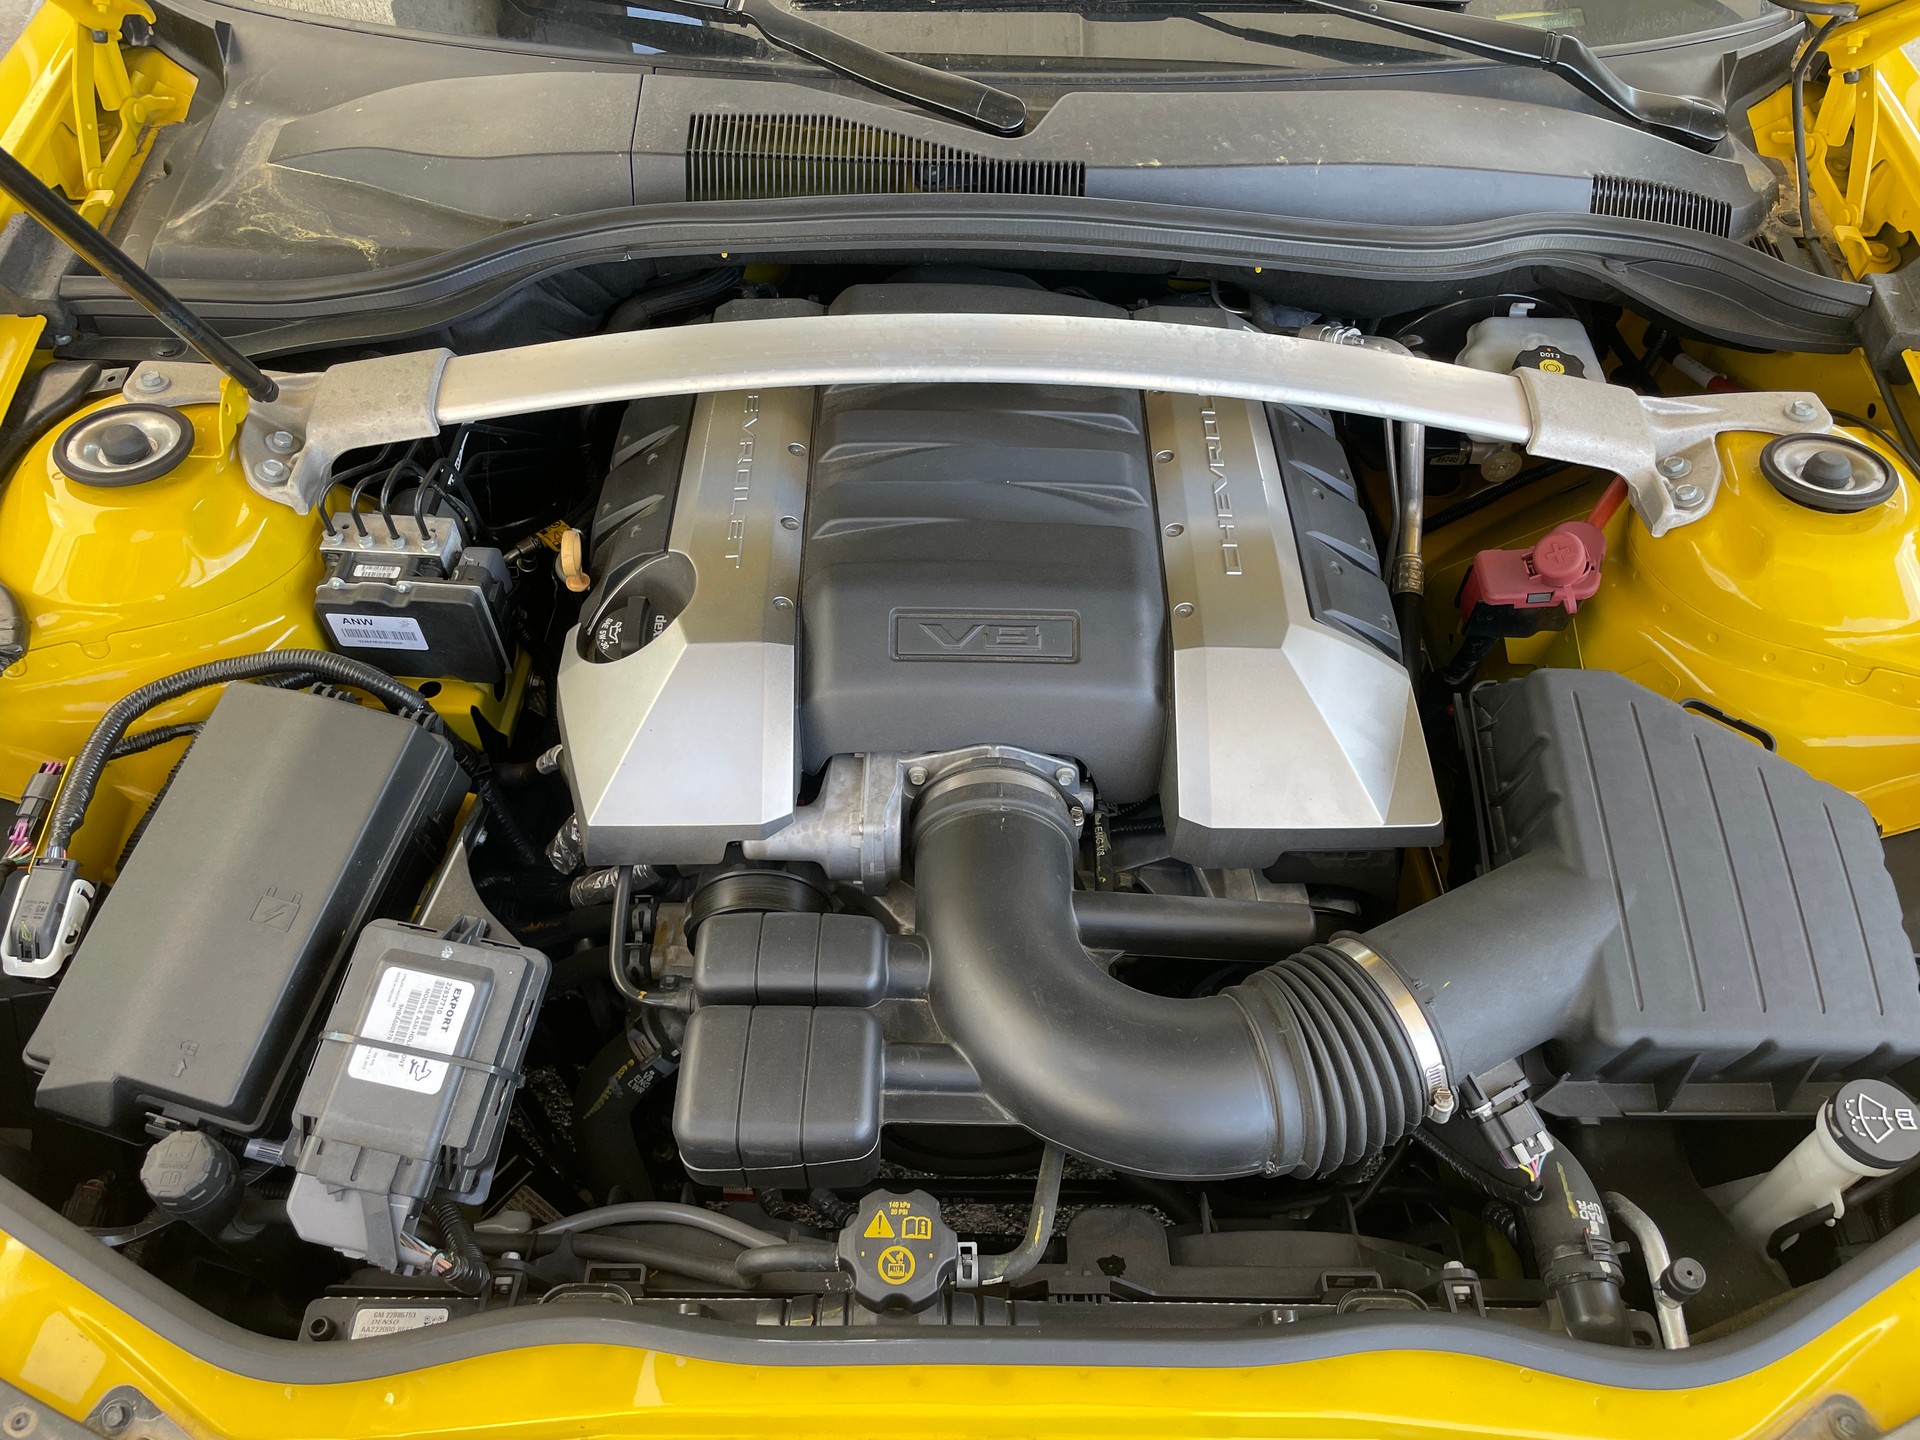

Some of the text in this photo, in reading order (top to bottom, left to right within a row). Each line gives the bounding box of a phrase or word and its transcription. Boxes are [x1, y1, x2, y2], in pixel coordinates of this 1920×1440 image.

[725, 395, 759, 569] EVROLET
[1201, 394, 1242, 576] CHEVROL
[342, 617, 373, 626] ANW
[601, 617, 614, 629] SAE
[653, 615, 667, 639] dex
[918, 622, 1042, 650] V8
[1094, 826, 1104, 844] ENG
[416, 988, 430, 1014] MODULE
[436, 982, 452, 1014] 22837710
[440, 988, 462, 1033] EXPORT
[397, 1052, 408, 1068] ONT
[627, 1079, 645, 1094] LWR
[634, 1074, 651, 1088] ENG
[1576, 1199, 1601, 1212] UPR
[1580, 1210, 1604, 1224] RAD
